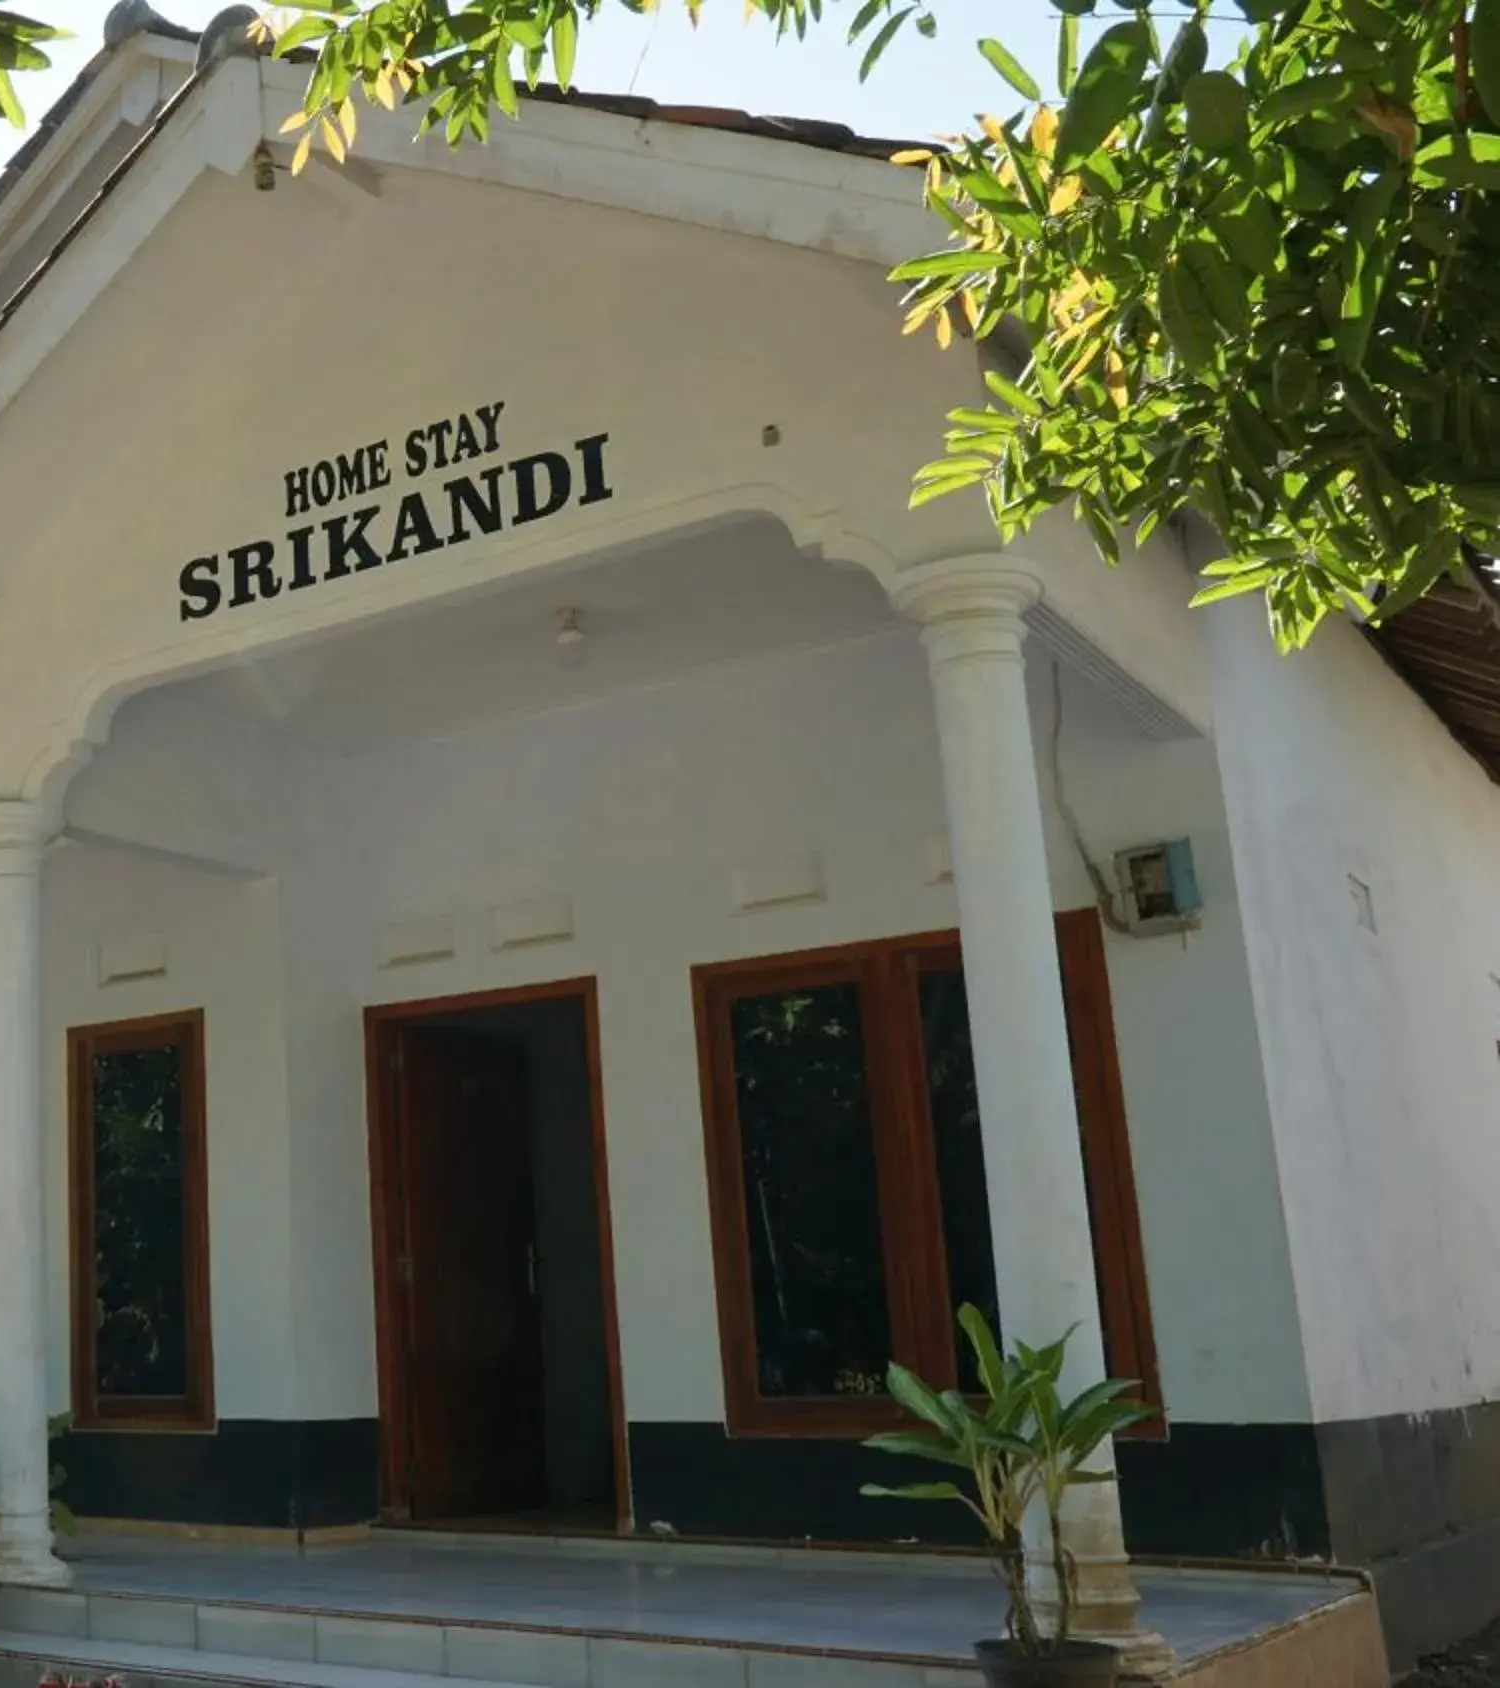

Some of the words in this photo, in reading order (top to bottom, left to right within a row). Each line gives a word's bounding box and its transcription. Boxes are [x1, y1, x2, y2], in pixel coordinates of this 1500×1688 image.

[178, 432, 613, 623] SRIKANDI
[283, 439, 392, 518] HOME
[404, 400, 506, 478] STAY
